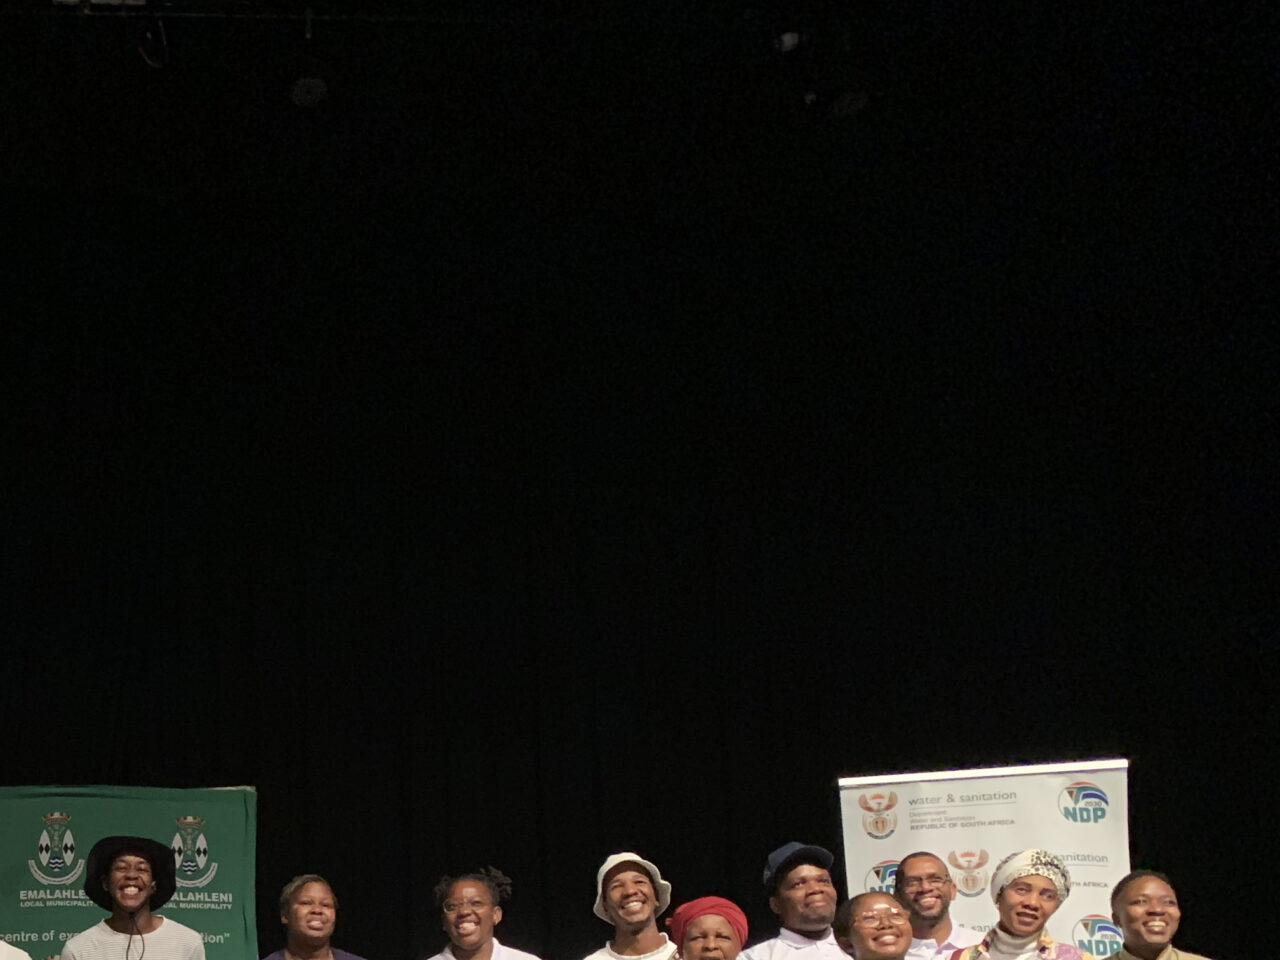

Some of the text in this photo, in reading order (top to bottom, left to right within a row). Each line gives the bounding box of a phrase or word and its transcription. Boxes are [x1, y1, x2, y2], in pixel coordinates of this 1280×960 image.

[908, 791, 1017, 806] water & sanitation
[1063, 807, 1106, 823] NDP
[180, 902, 232, 910] MUNICIPALITY
[42, 930, 55, 941] of
[1078, 939, 1123, 956] NDP
